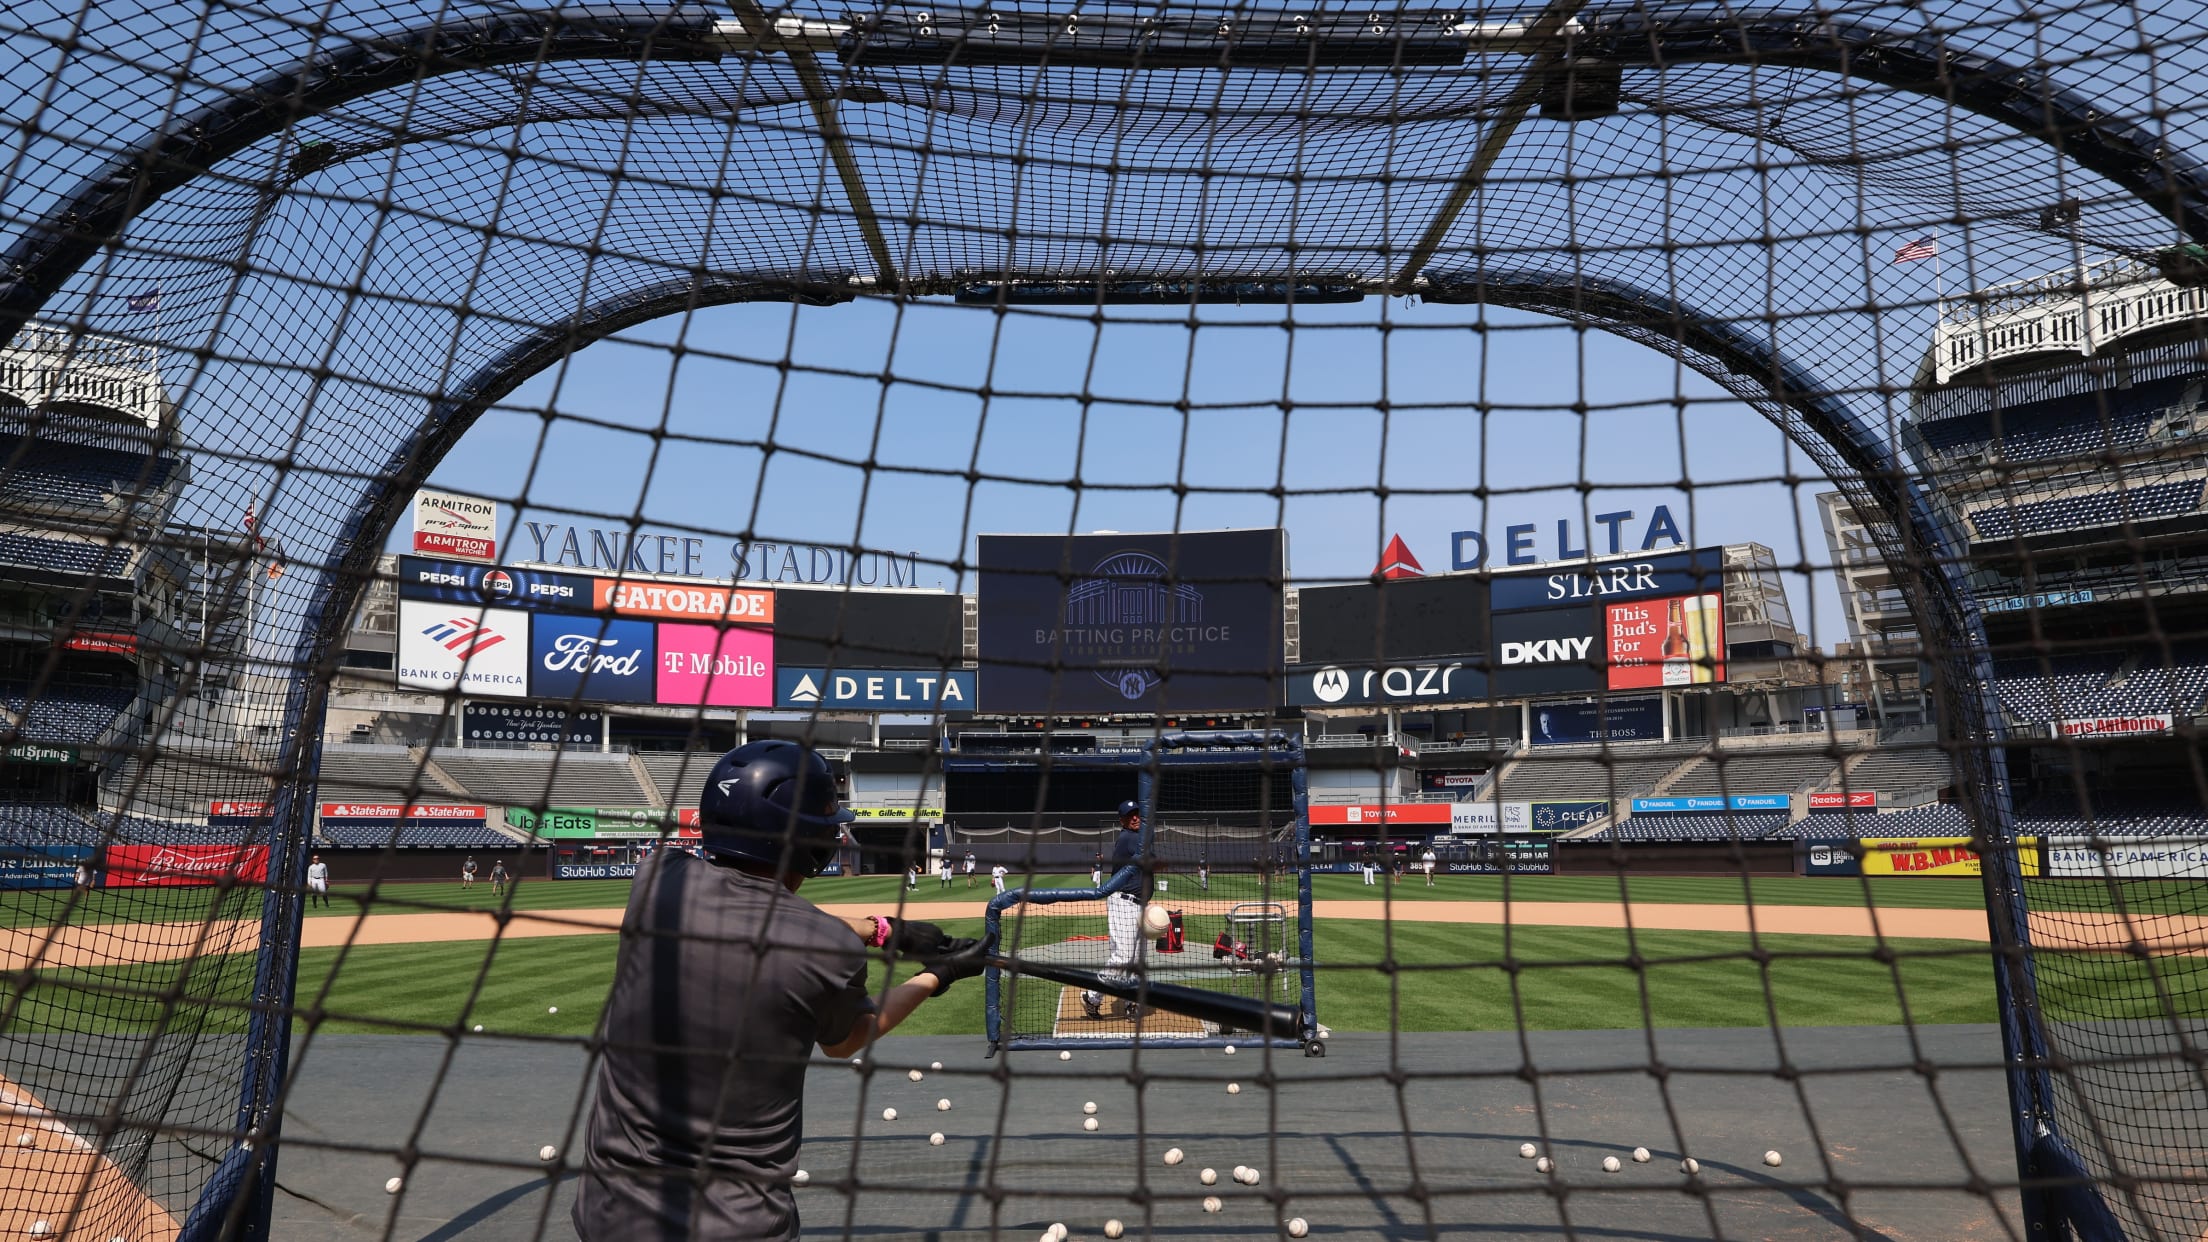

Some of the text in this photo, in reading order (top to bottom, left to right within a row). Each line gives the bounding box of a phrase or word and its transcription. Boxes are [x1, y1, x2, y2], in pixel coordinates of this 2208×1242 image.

[421, 498, 492, 515] ARMITRON
[424, 536, 488, 551] ARMITRON
[1451, 505, 1685, 571] DELTA
[456, 547, 486, 556] WATCHES
[525, 521, 920, 588] YANKEE STADIUM
[419, 572, 465, 587] PEPSI
[484, 580, 511, 590] PEPSI
[1547, 563, 1660, 601] STARR
[530, 583, 573, 597] PEPSI
[605, 586, 765, 617] GATORADE
[1611, 606, 1649, 622] This
[1035, 626, 1230, 644] BATTING PRACTICE
[1501, 636, 1593, 665] DKNY
[1613, 639, 1640, 653] For
[544, 634, 642, 676] Ford
[1613, 654, 1649, 668] You.
[690, 653, 765, 677] Mobile
[401, 668, 523, 684] BANK OF AMERICA
[1362, 662, 1463, 698] razr
[836, 677, 963, 701] DELTA
[520, 720, 534, 730] York
[2097, 717, 2165, 731] Authority
[1611, 729, 1636, 737] BOSS
[27, 745, 70, 762] Spring
[350, 806, 400, 816] State Farm
[428, 806, 475, 817] State Farm
[553, 815, 591, 829] Eats
[1454, 815, 1501, 824] MERRIL
[22, 854, 89, 868] Einstei
[1814, 850, 1828, 860] GS
[1891, 844, 1981, 871] W.B.MA
[2053, 852, 2208, 861] BANK OF AMERICA
[150, 856, 249, 875] Budweisr
[561, 866, 605, 877] StubHub
[1348, 862, 1381, 871] STAR
[1450, 863, 1549, 871] StubHub Stuub StubHub
